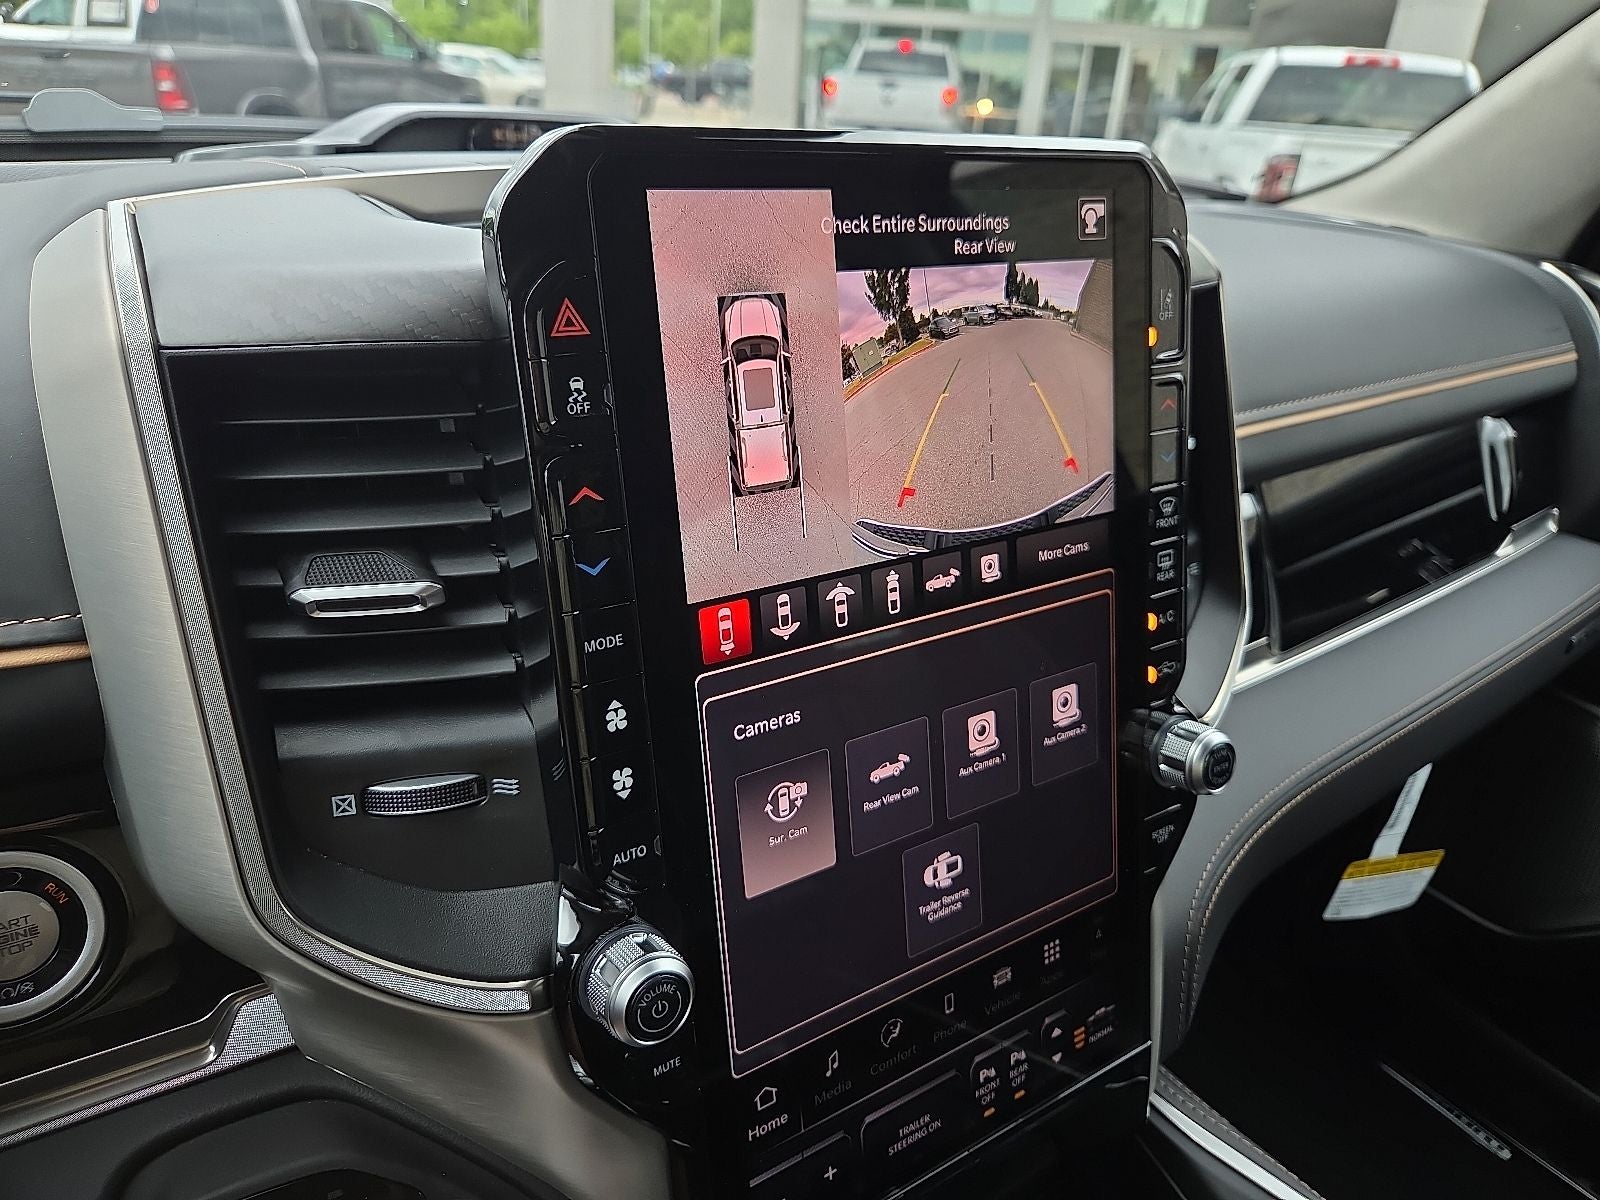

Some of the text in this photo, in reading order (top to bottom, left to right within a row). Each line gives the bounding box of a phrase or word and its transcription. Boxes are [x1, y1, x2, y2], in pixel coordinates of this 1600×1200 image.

[820, 212, 1010, 235] Check Entire Surroundings
[954, 237, 1016, 256] Rear View
[1159, 311, 1174, 321] OFF
[567, 402, 591, 415] OFF
[1156, 515, 1179, 529] FRONT
[1038, 541, 1090, 563] More Cams
[1156, 569, 1176, 582] REAR
[584, 633, 624, 654] MODE
[733, 710, 801, 741] Cameras
[1043, 735, 1057, 747] Aux
[1056, 727, 1081, 741] Camera
[958, 764, 973, 777] Aux
[973, 755, 1000, 772] Camera
[863, 785, 920, 813] Rear View Cam
[769, 825, 808, 847] Sur. Cam
[1151, 824, 1175, 839] SCREEN
[1156, 832, 1169, 844] OFF
[613, 845, 647, 867] AUTO
[44, 882, 70, 904] RUN
[918, 887, 971, 916] Trailer Reverse
[927, 901, 963, 924] Guidance
[639, 983, 677, 1007] VOLUME
[933, 1019, 967, 1043] Phone
[653, 1056, 681, 1077] MUTE
[870, 1044, 918, 1076] Comfort
[1009, 1062, 1029, 1079] REAR
[975, 1078, 1001, 1099] FRONT
[1011, 1073, 1026, 1088] OFF
[813, 1080, 852, 1106] Media
[981, 1092, 996, 1105] OFF
[748, 1113, 789, 1142] Home
[899, 1113, 931, 1138] TRAILER
[888, 1119, 942, 1156] STEERING ON
